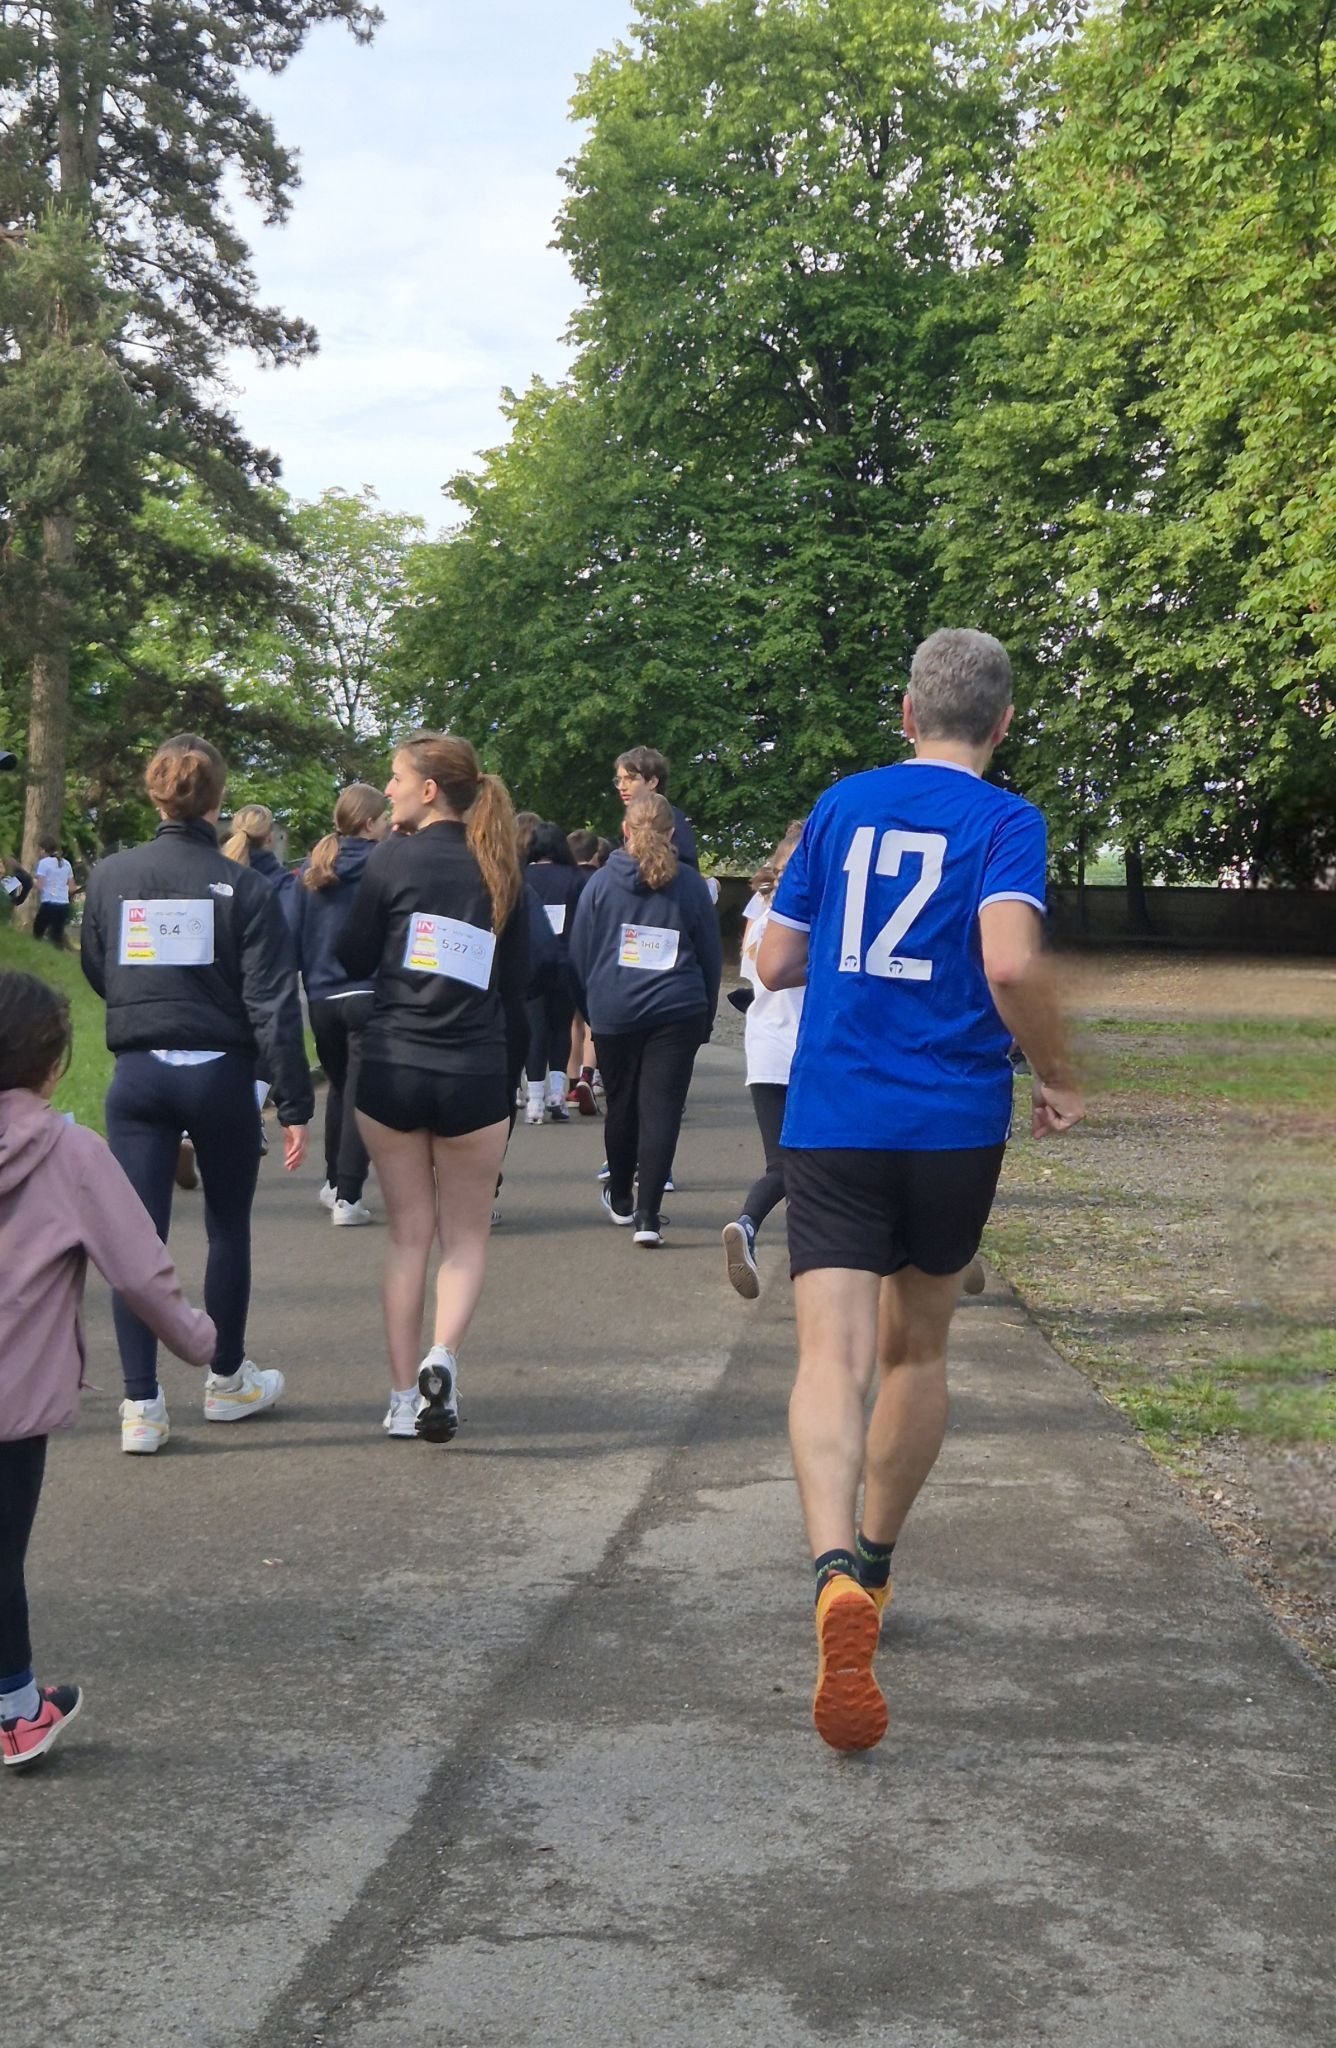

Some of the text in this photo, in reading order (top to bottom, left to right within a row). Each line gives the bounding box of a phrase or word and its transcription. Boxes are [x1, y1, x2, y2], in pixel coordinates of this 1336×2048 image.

[838, 827, 948, 981] 12
[130, 909, 145, 919] IN
[159, 923, 180, 936] 6.4
[418, 921, 433, 931] IN
[442, 938, 468, 954] 5.27
